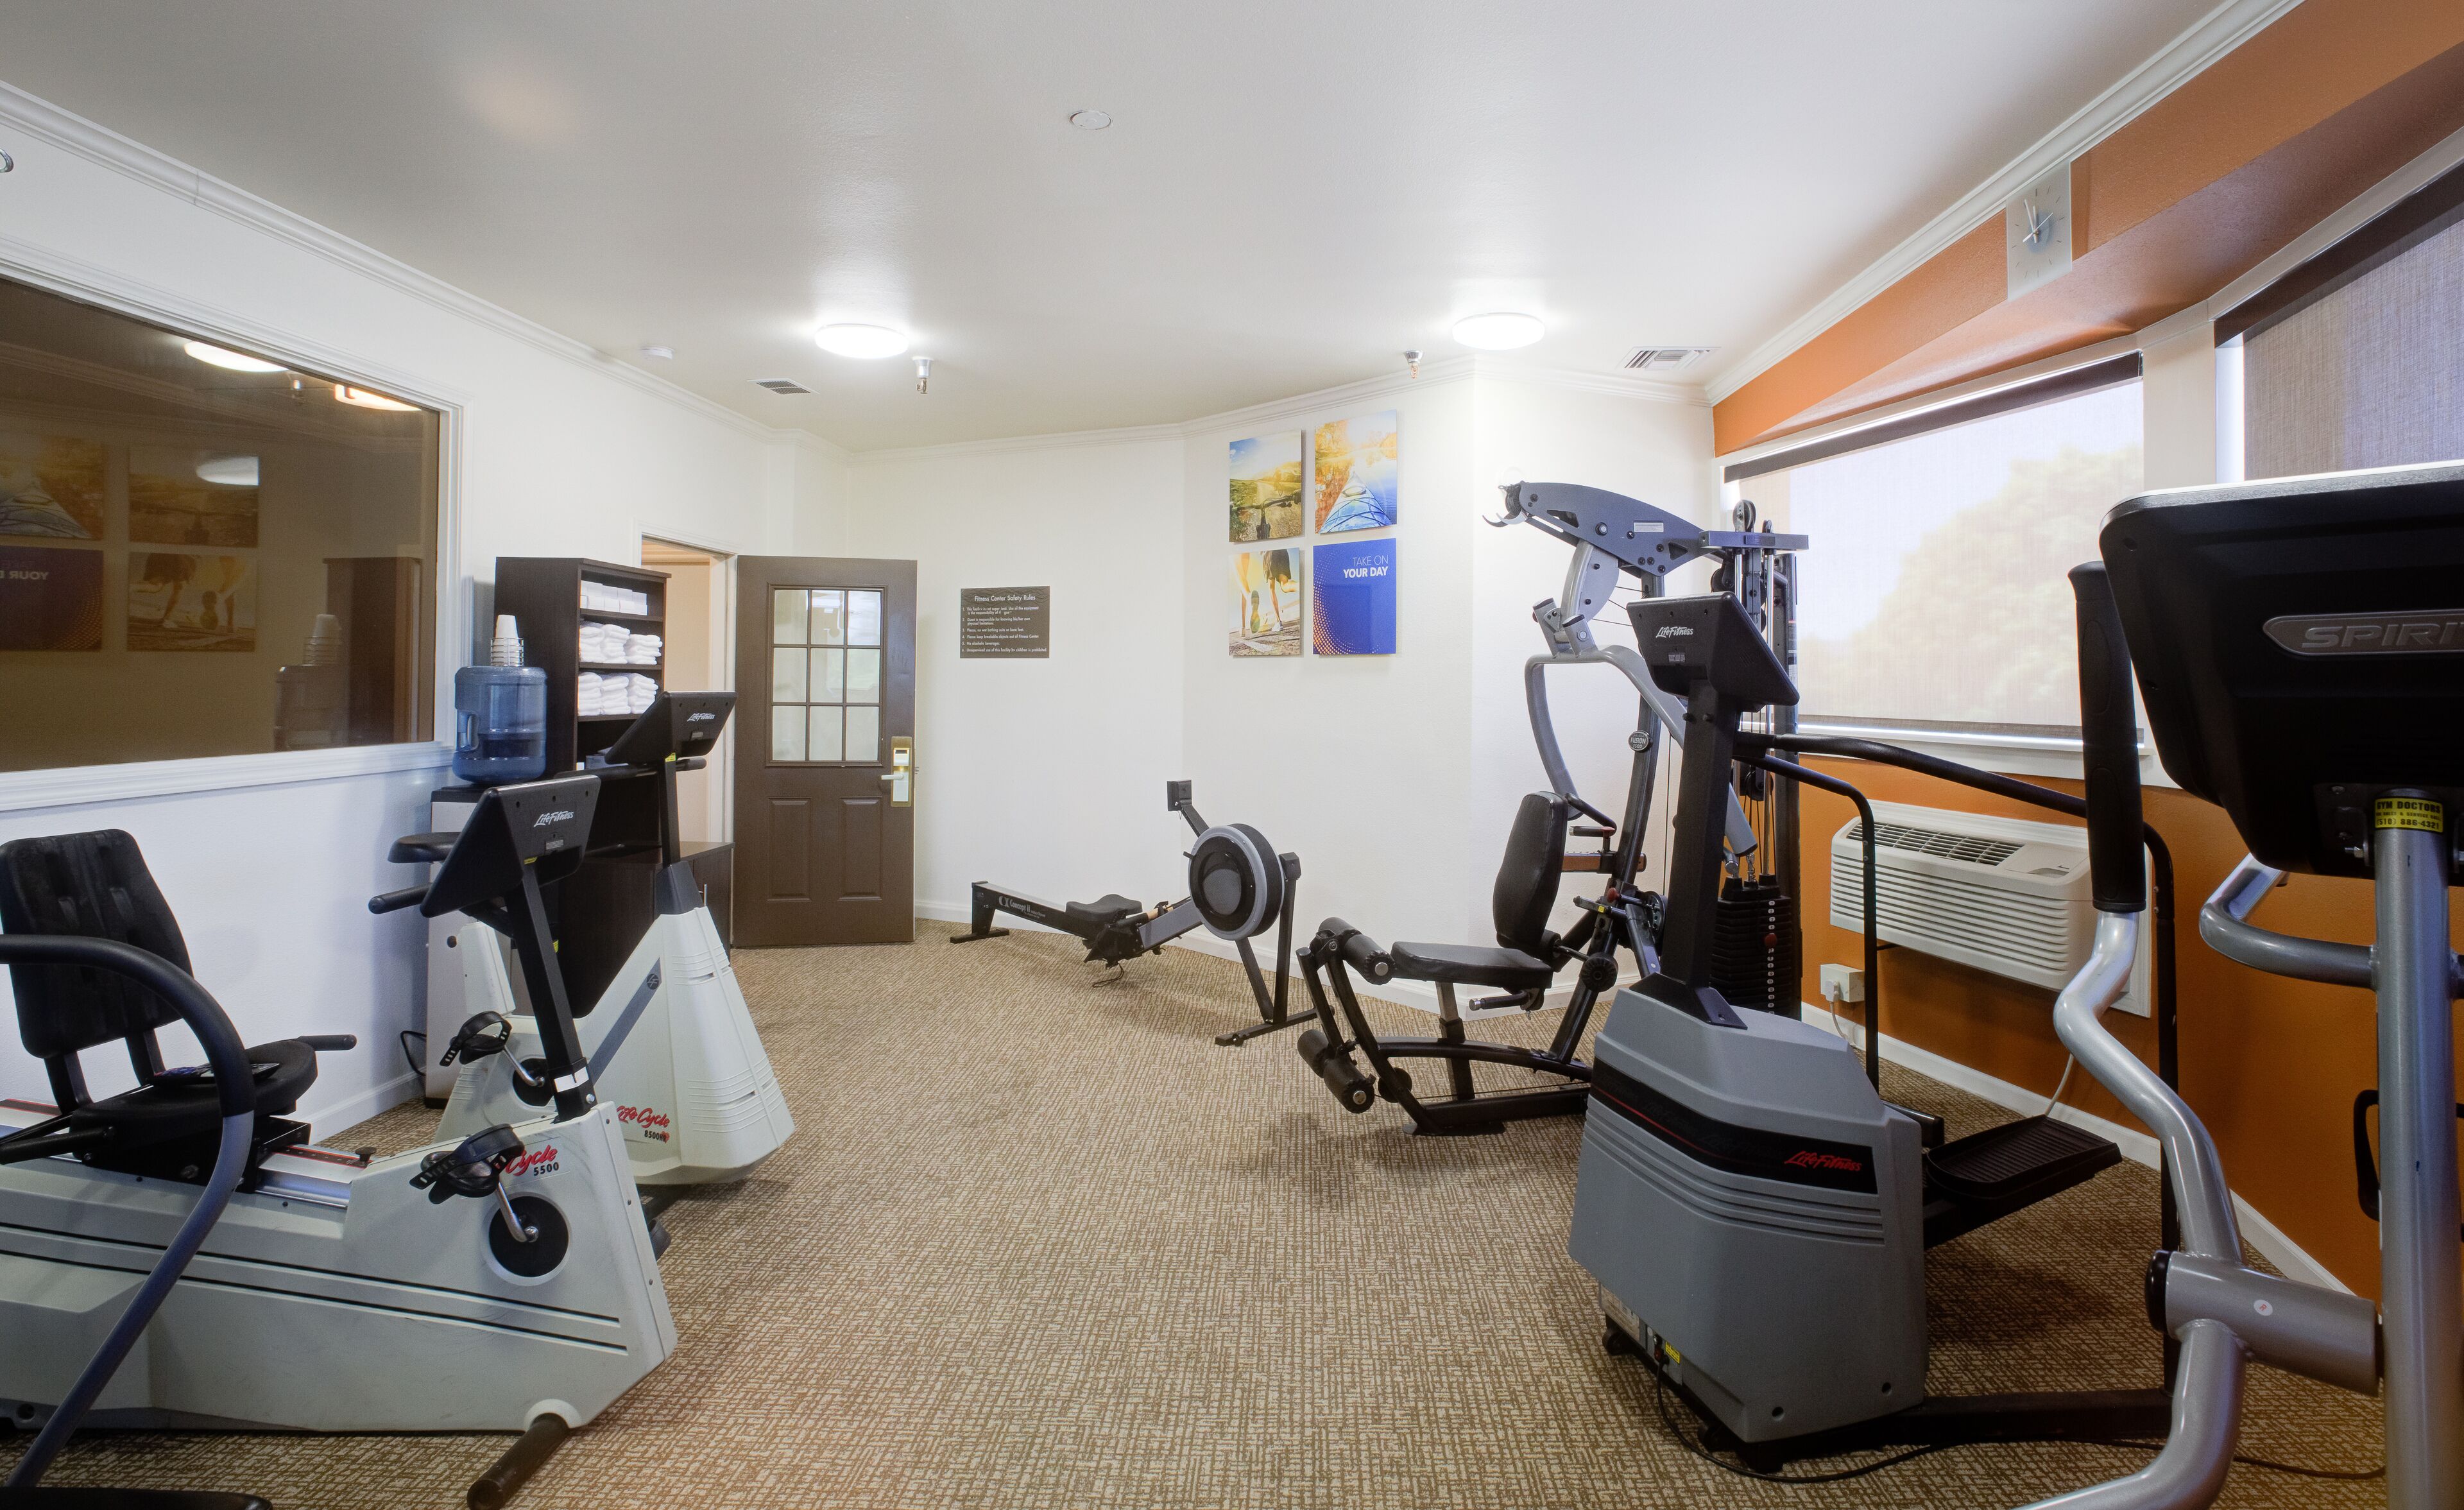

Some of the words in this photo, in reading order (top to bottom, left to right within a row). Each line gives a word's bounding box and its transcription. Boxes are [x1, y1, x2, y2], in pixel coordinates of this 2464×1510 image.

[1353, 556, 1371, 566] TAKE
[1374, 555, 1389, 565] ON
[1343, 568, 1368, 578] YOUR
[1370, 566, 1389, 577] DAY
[2302, 622, 2464, 648] SPIRI
[2397, 801, 2441, 814] DOCTORS
[2400, 818, 2439, 830] 886-4321
[637, 1108, 670, 1129] Cycle
[533, 1162, 560, 1176] 5500
